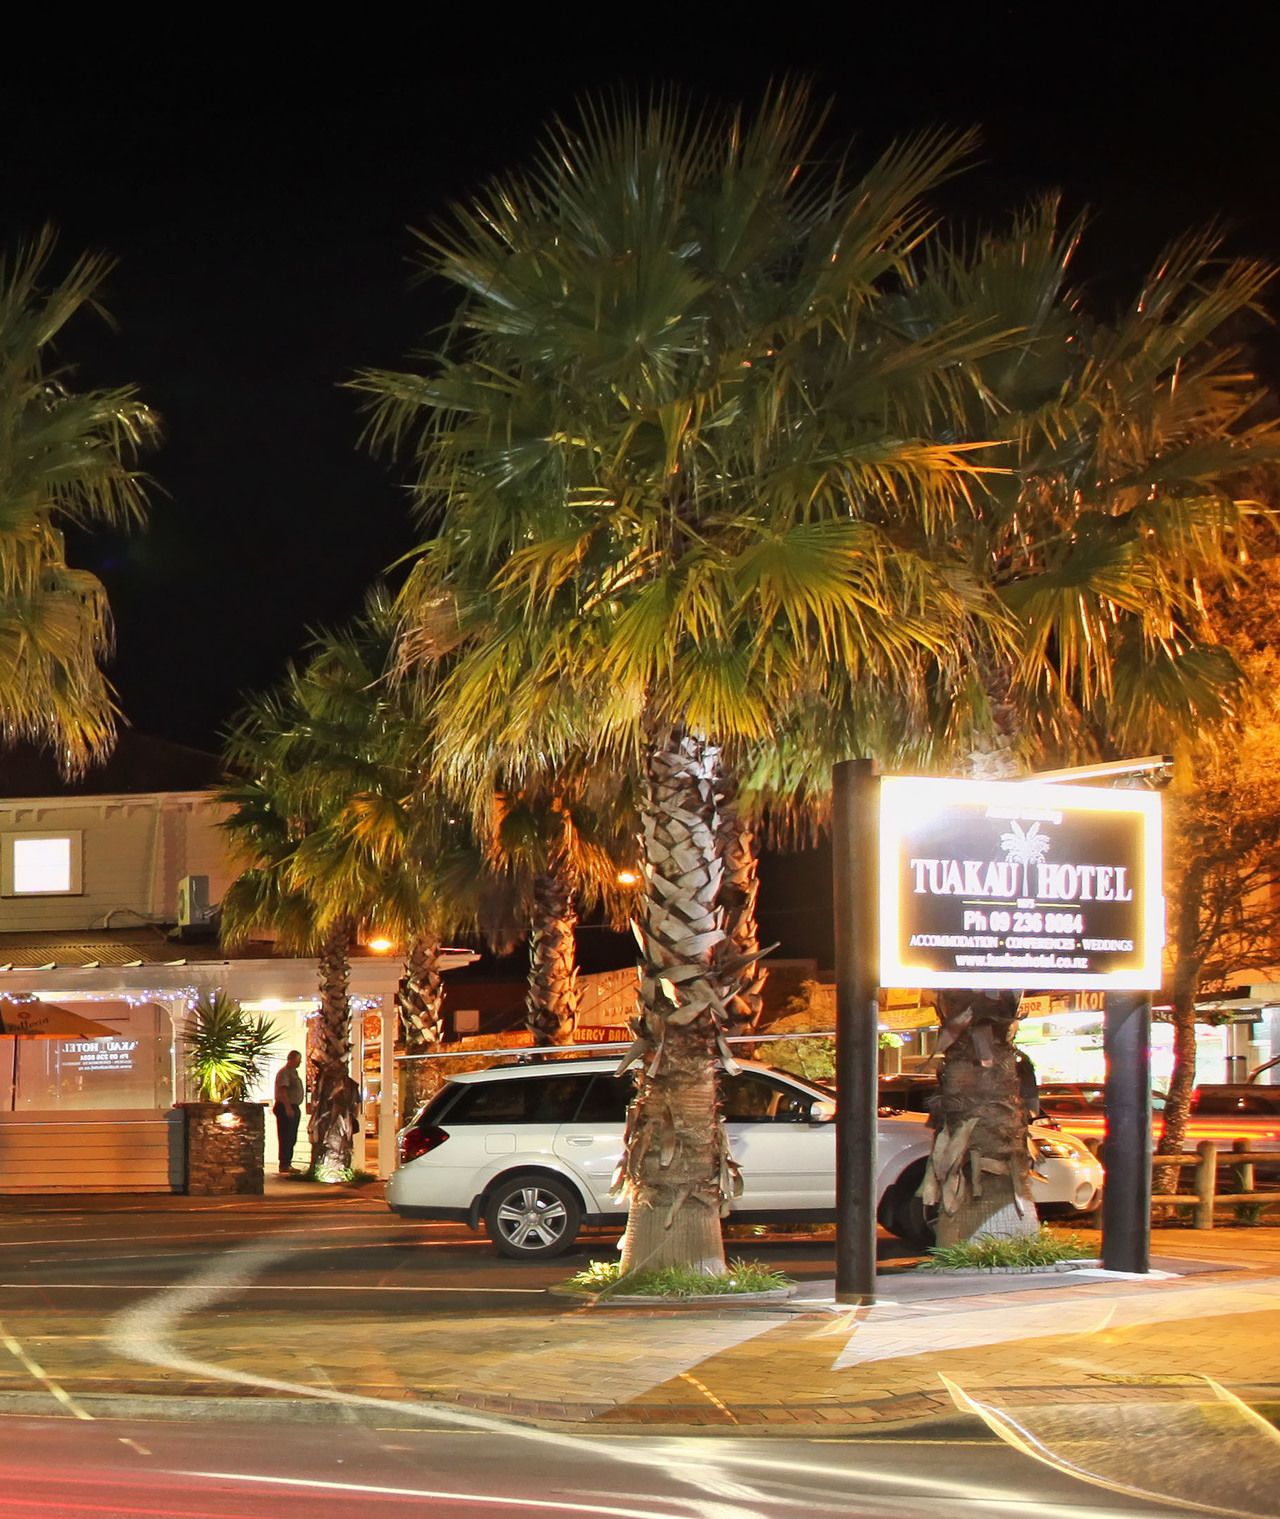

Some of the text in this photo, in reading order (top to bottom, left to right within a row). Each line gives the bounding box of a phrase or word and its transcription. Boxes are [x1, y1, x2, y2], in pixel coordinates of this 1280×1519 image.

[910, 859, 1133, 901] TUAKAU HOTEL
[964, 911, 987, 931] Ph
[1013, 912, 1043, 933] 236
[909, 934, 998, 948] ACCOMMODATION
[1082, 939, 1134, 951] WEDDINGS
